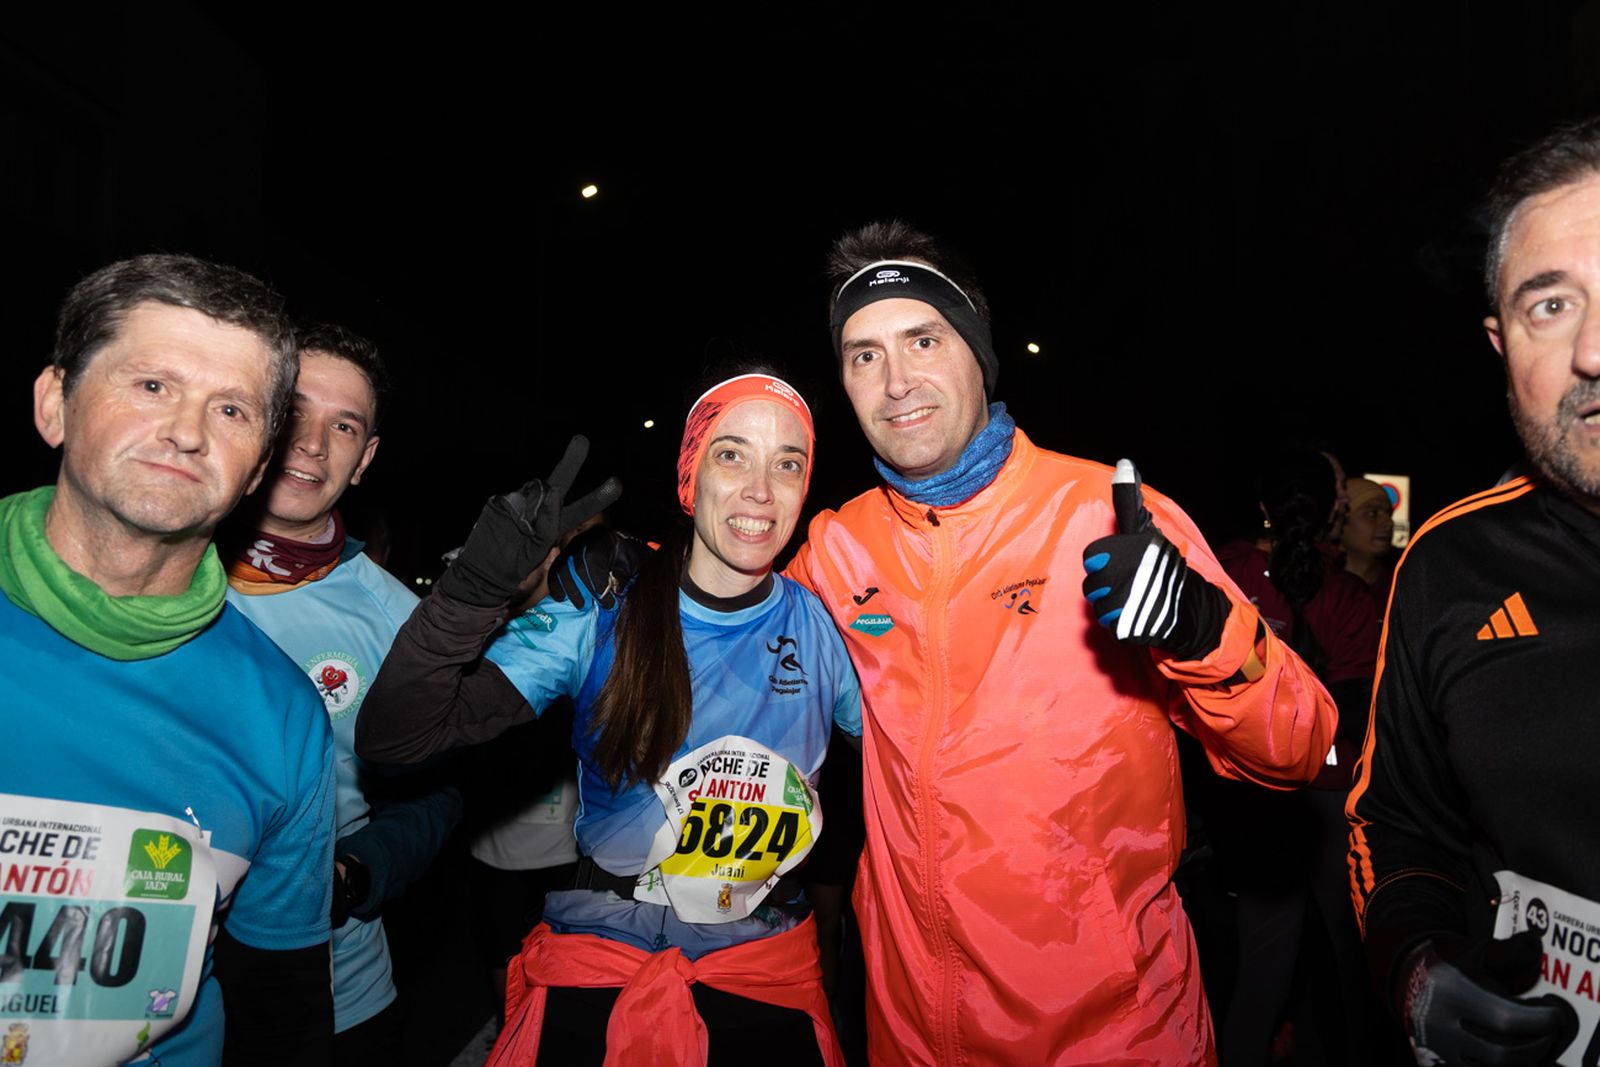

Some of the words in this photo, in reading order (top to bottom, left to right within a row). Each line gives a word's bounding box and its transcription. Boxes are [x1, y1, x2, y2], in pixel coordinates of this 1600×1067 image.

[731, 750, 770, 761] INTERCIONAL
[2, 816, 37, 828] URBANA
[38, 821, 103, 834] INTERNACIONAL
[675, 801, 800, 862] 5824
[61, 834, 101, 860] DE
[0, 859, 95, 896] NTÓN
[154, 871, 185, 883] RURAL
[711, 863, 746, 879] Juani
[1527, 904, 1548, 931] 43
[1553, 911, 1585, 930] CARRERA
[1551, 923, 1600, 963] NOC
[1540, 952, 1571, 990] AN
[1576, 969, 1600, 1003] A
